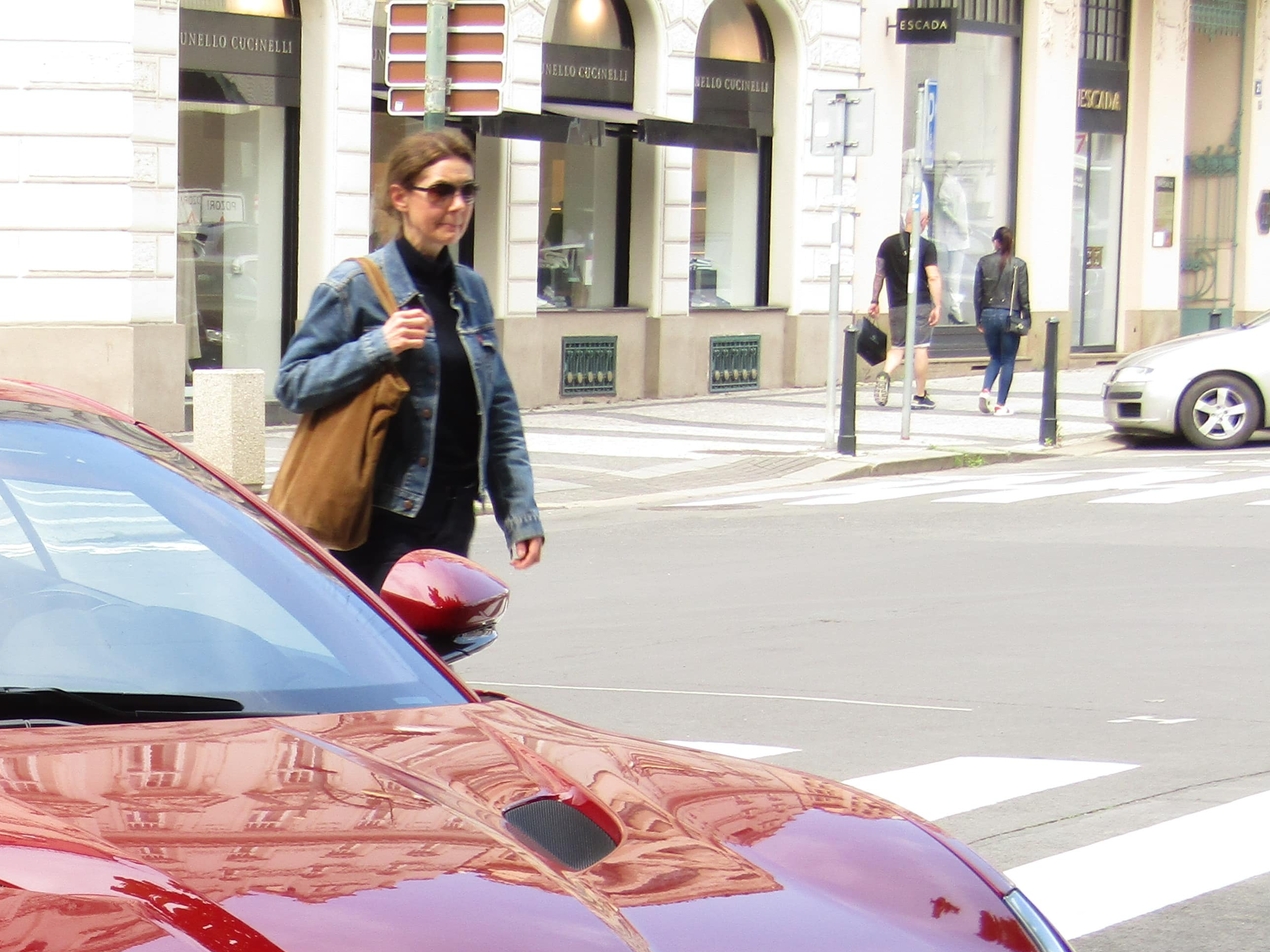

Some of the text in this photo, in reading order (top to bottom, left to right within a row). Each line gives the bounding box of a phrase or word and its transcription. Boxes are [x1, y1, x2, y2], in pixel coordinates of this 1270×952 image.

[899, 20, 947, 31] ESCADA
[231, 36, 292, 54] CUCINELLI
[578, 66, 628, 81] CUCINELLI
[724, 78, 769, 93] CUCINELLI
[1077, 88, 1122, 111] ESCADA
